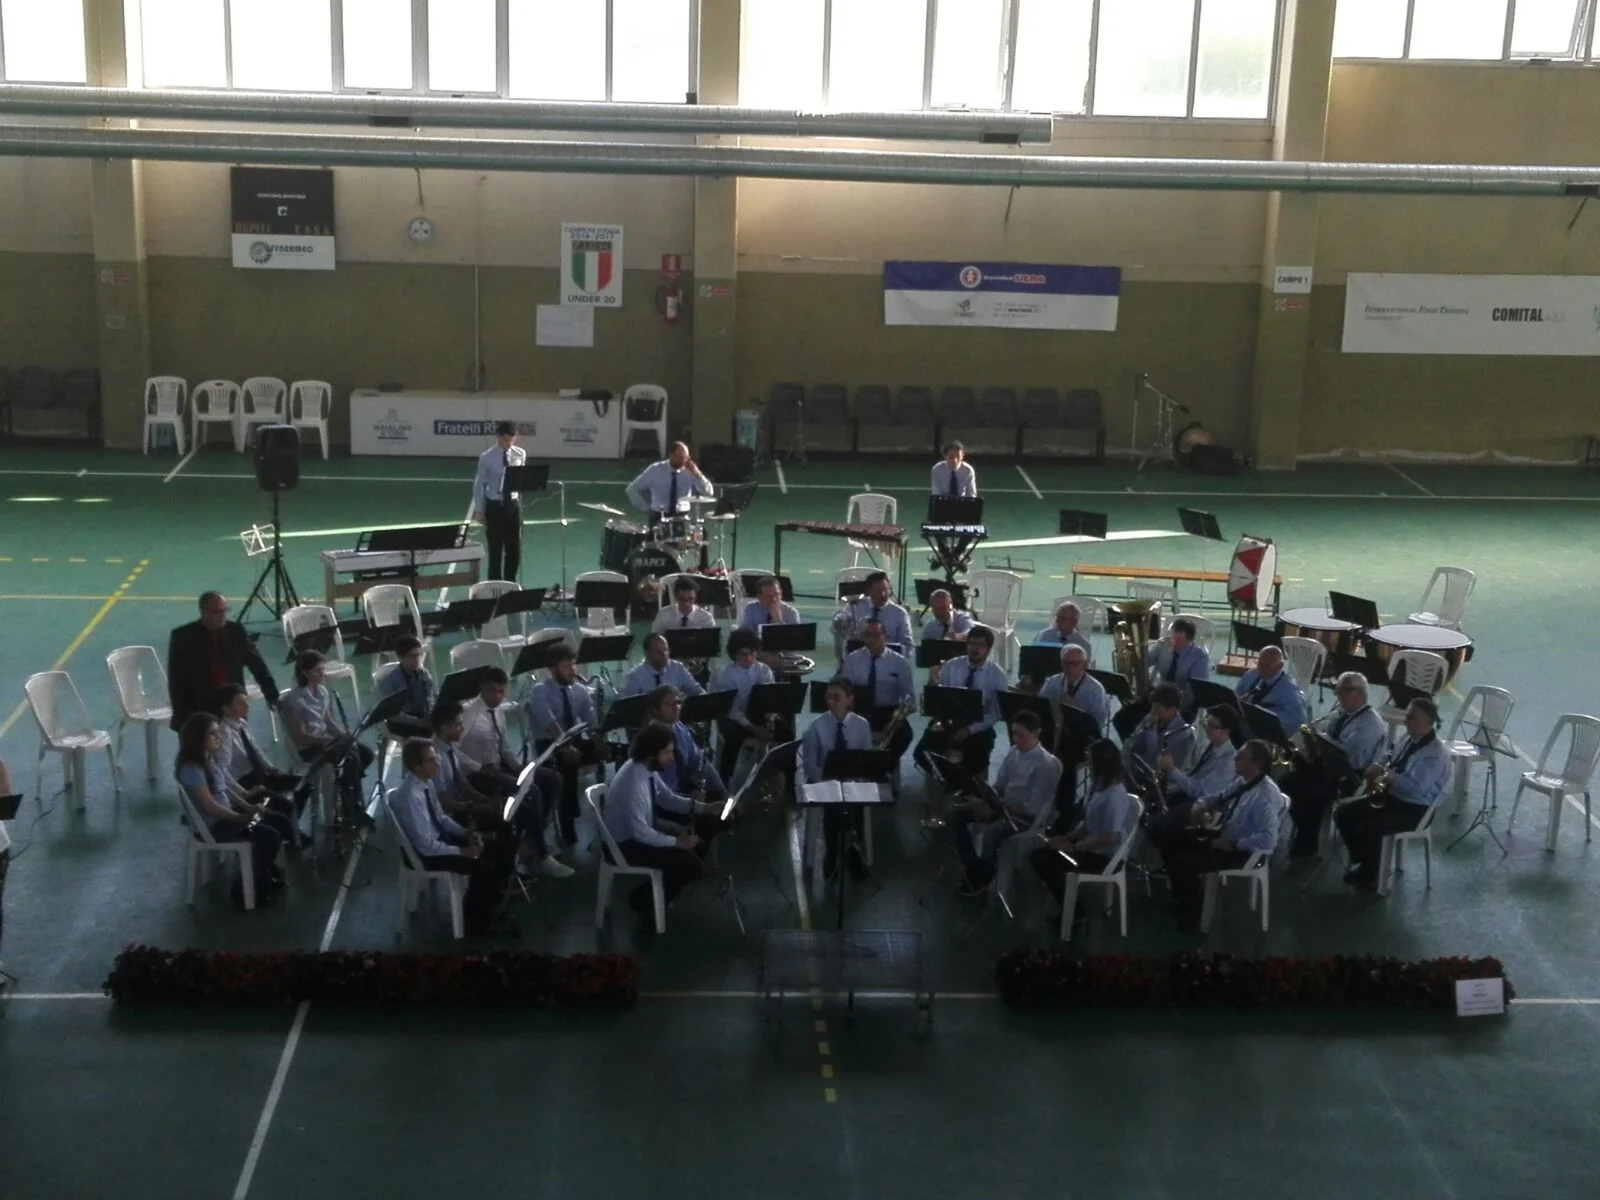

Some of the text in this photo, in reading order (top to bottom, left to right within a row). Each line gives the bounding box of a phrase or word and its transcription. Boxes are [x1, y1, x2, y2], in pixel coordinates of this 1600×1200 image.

[1278, 276, 1302, 284] CAMPO
[567, 295, 616, 304] UNDER 20
[1492, 307, 1543, 322] COMITAL
[437, 422, 481, 434] Fratelli
